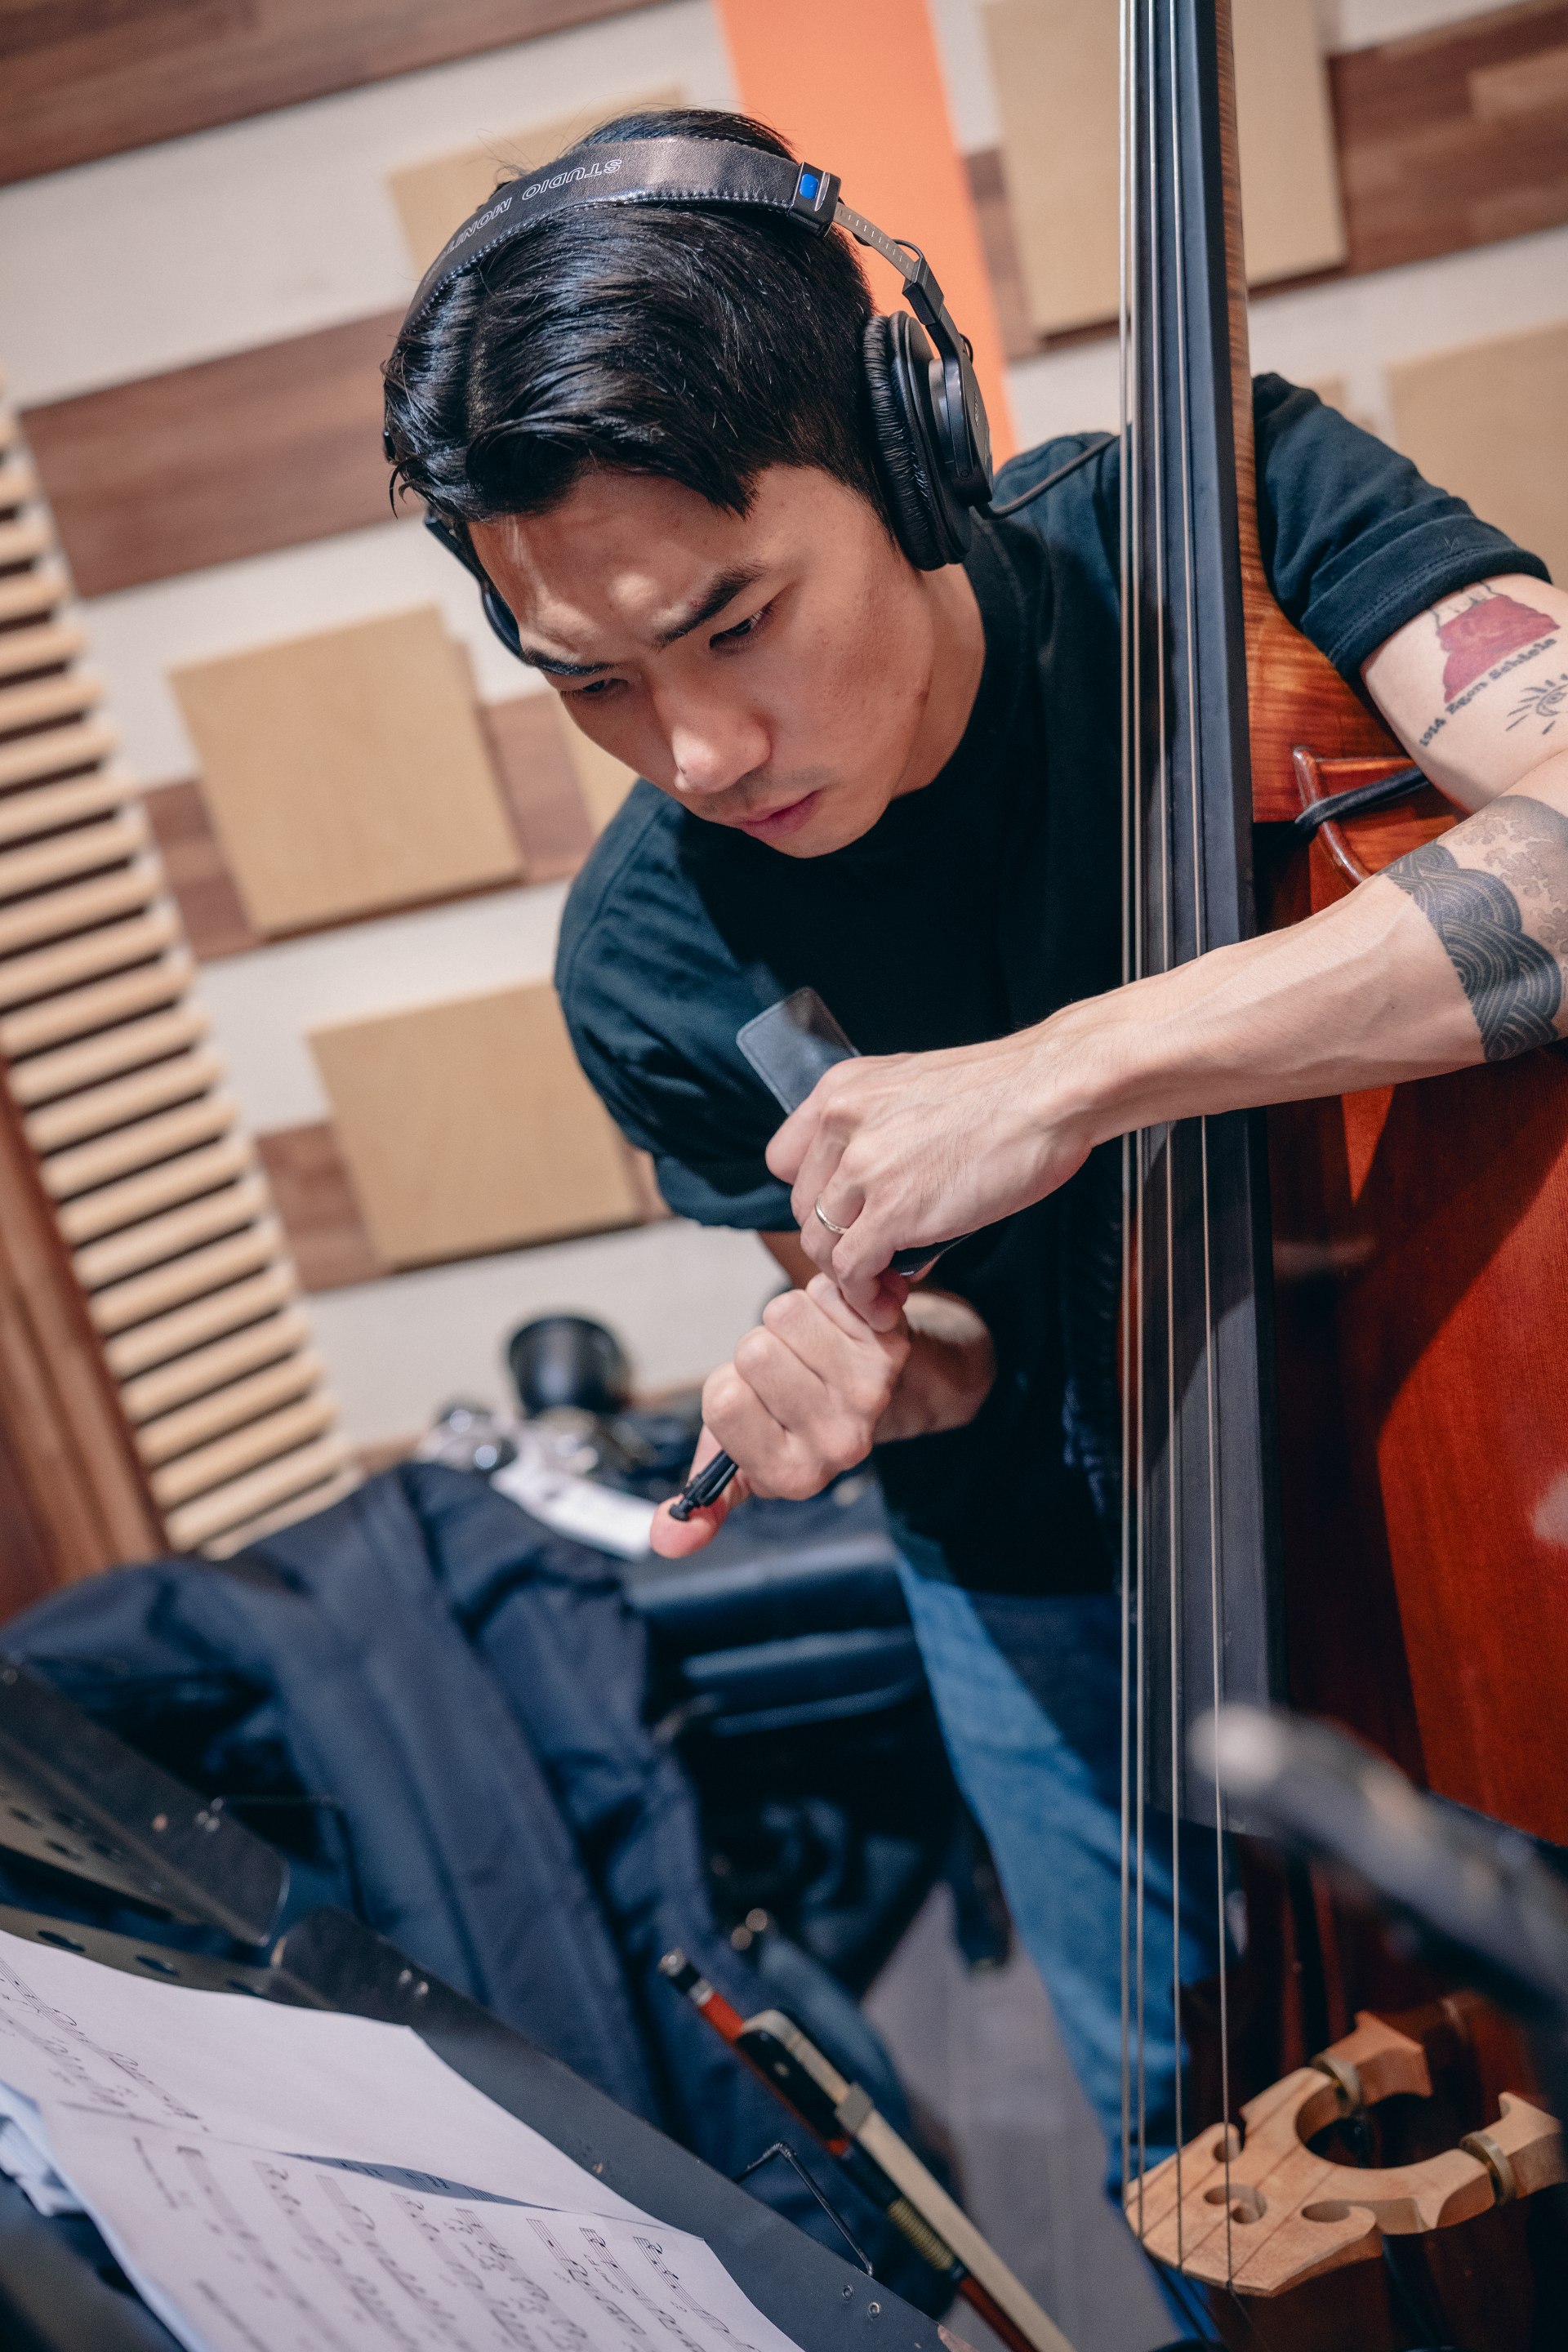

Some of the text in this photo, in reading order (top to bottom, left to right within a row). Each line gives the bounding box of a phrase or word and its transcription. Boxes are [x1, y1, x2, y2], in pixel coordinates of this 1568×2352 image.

[439, 159, 622, 262] STUDIO MONIT
[1419, 718, 1446, 747] 1914
[1445, 682, 1488, 715] Egon
